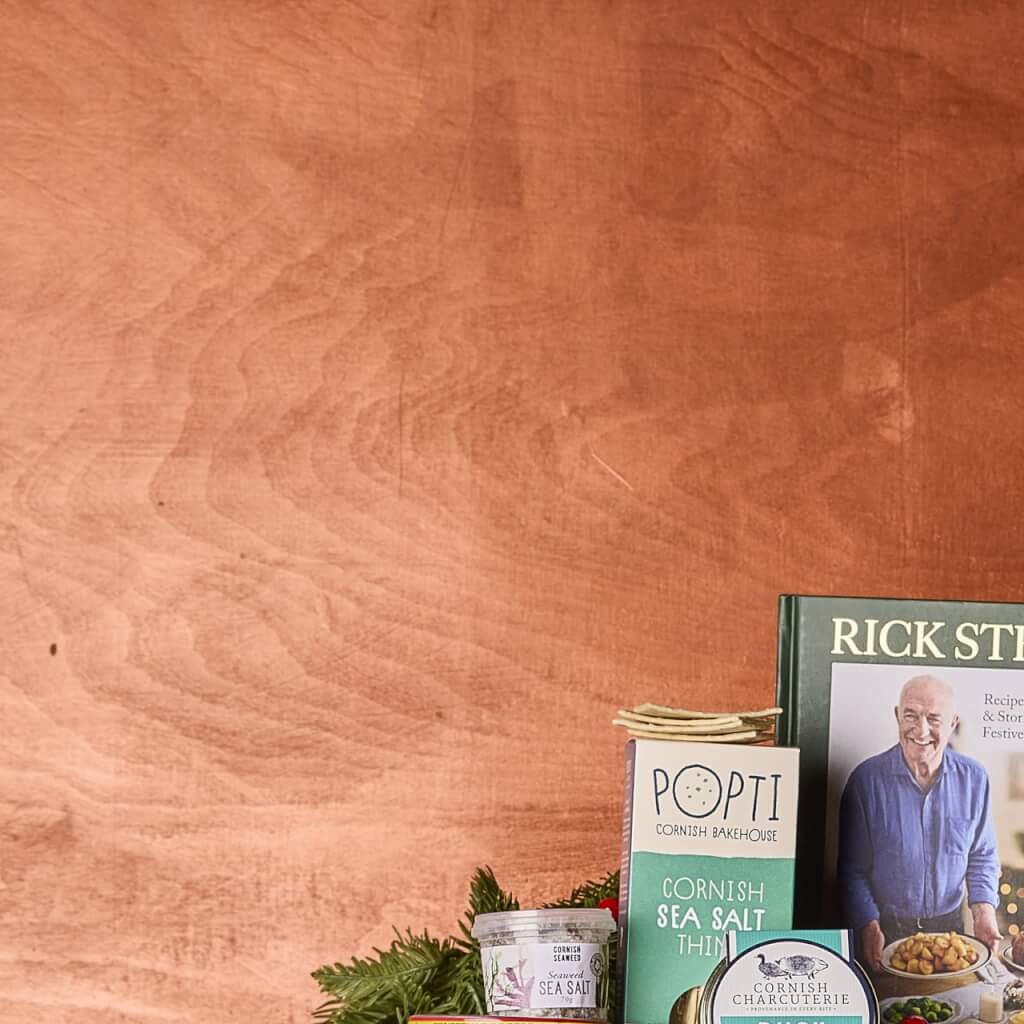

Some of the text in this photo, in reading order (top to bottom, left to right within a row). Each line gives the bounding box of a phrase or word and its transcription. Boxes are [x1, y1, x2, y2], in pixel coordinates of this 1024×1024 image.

[831, 617, 946, 659] RICK
[982, 710, 995, 722] &
[983, 726, 1024, 739] Festive
[653, 764, 782, 822] POPTI
[656, 824, 778, 842] CORNISH BAKEHOUSE
[663, 877, 764, 903] CORNISH
[657, 904, 766, 931] SEA SALT
[553, 945, 581, 953] CORNISH
[678, 934, 726, 957] THIN
[553, 954, 581, 962] SEAWEED
[539, 979, 591, 995] SEA SALT
[753, 982, 828, 994] CORNISH
[732, 993, 850, 1005] CHARCUTERIE
